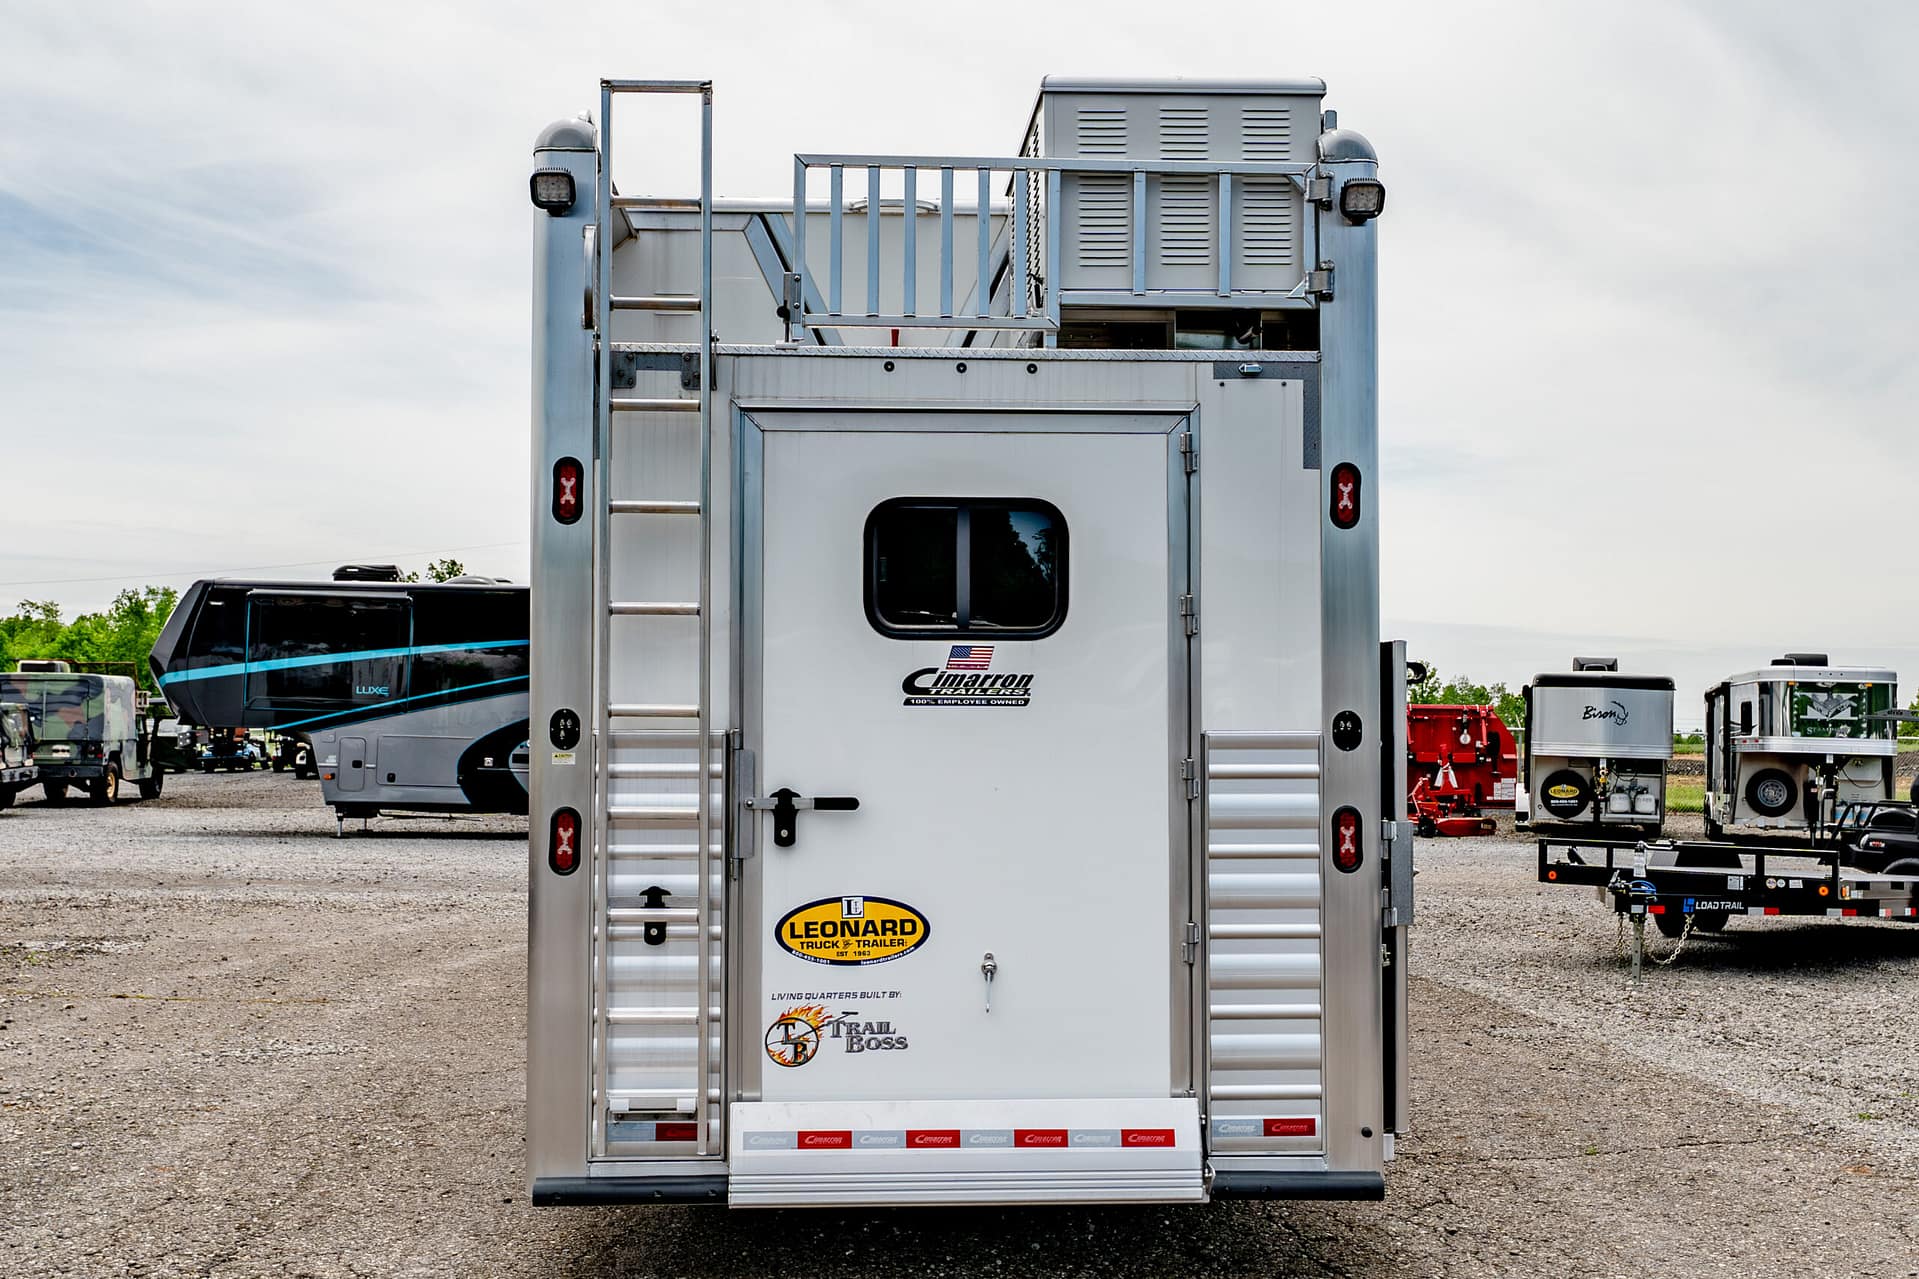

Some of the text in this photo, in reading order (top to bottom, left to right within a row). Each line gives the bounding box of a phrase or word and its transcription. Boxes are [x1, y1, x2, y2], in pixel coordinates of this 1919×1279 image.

[902, 667, 1034, 696] Cimarron
[355, 685, 390, 695] LUXE
[1582, 705, 1617, 720] Bison
[1695, 901, 1745, 910] LOAD TRAIL
[789, 918, 918, 939] LEONARD
[799, 940, 840, 950] TRUCK
[855, 938, 905, 948] TRAILER
[771, 992, 804, 1001] LIVING
[804, 991, 858, 1000] QUARTERS
[860, 991, 886, 999] BUILT
[825, 1020, 897, 1038] TRAIL
[845, 1035, 909, 1053] BOSS
